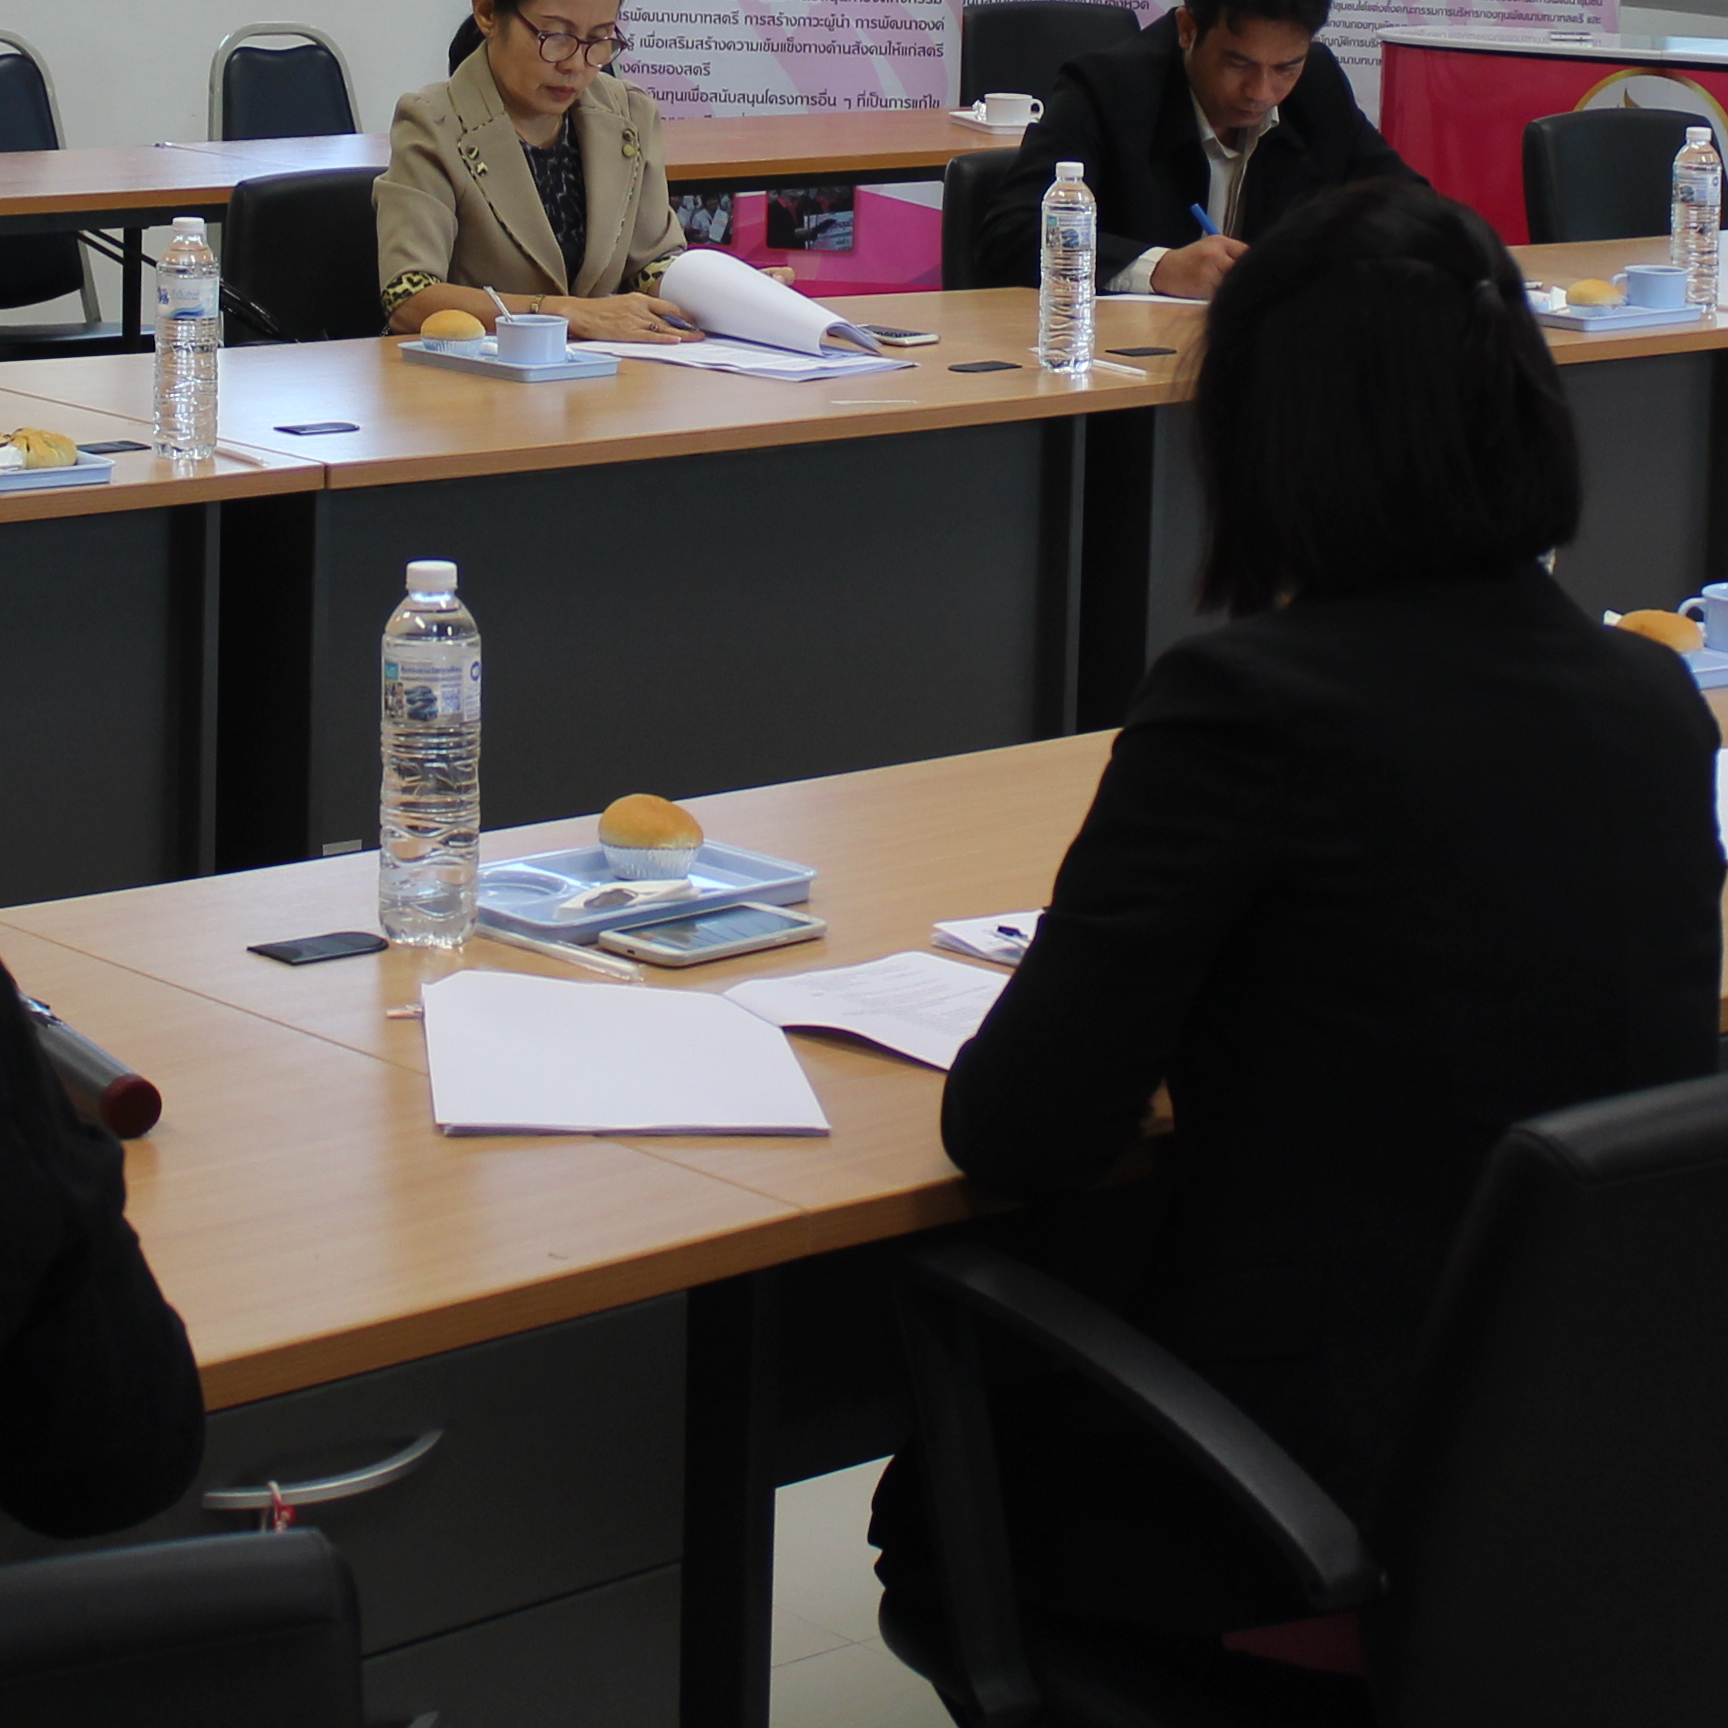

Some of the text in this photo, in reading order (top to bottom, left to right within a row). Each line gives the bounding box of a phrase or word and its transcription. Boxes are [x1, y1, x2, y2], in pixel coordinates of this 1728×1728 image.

[744, 12, 850, 31] การสร้างภาวะผู้นำ
[855, 15, 944, 31] การพัฒนาองค์
[640, 31, 943, 57] เพื่อเสริมสร้างความเข้มแข็งทางด้านสังคมให้แก่สตรี
[857, 90, 939, 113] ที่เป็นการแก้ไข
